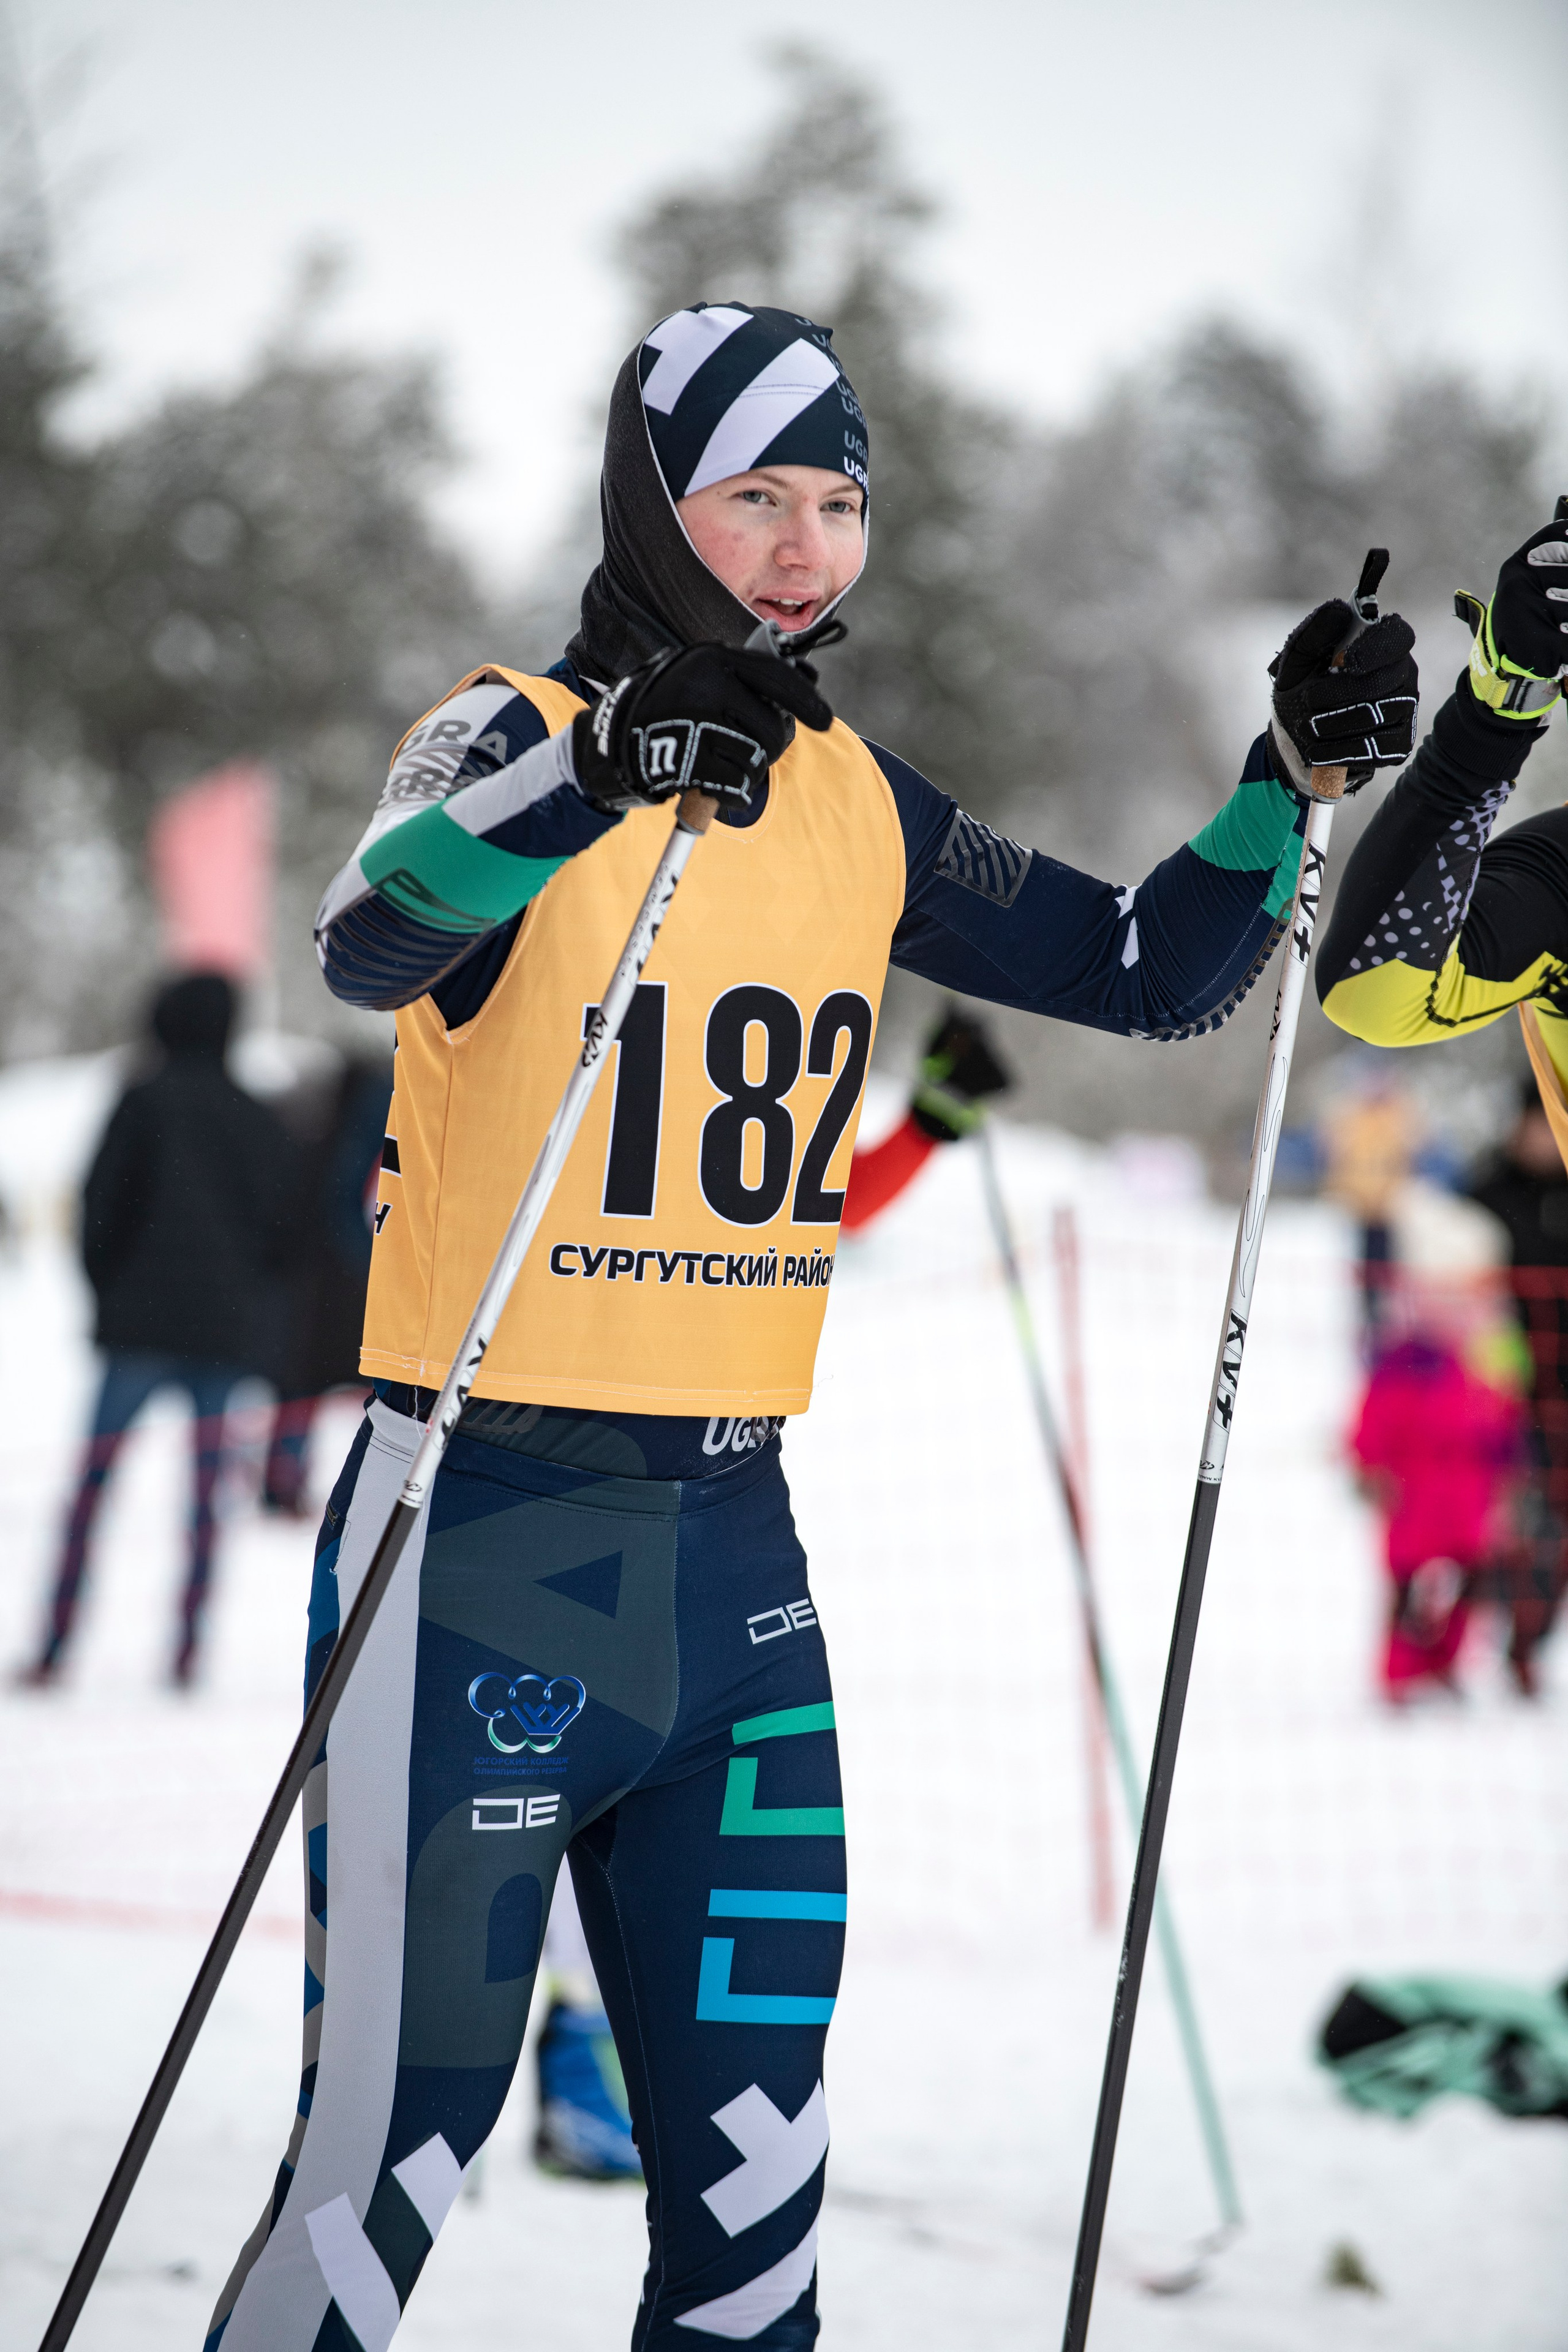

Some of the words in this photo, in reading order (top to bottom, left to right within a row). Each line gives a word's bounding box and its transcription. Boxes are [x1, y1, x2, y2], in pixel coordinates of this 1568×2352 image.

[843, 455, 869, 496] UGR
[580, 980, 873, 1228] 182
[549, 1243, 778, 1288] СУРГУТСКИЙ
[472, 1793, 561, 1831] DE
